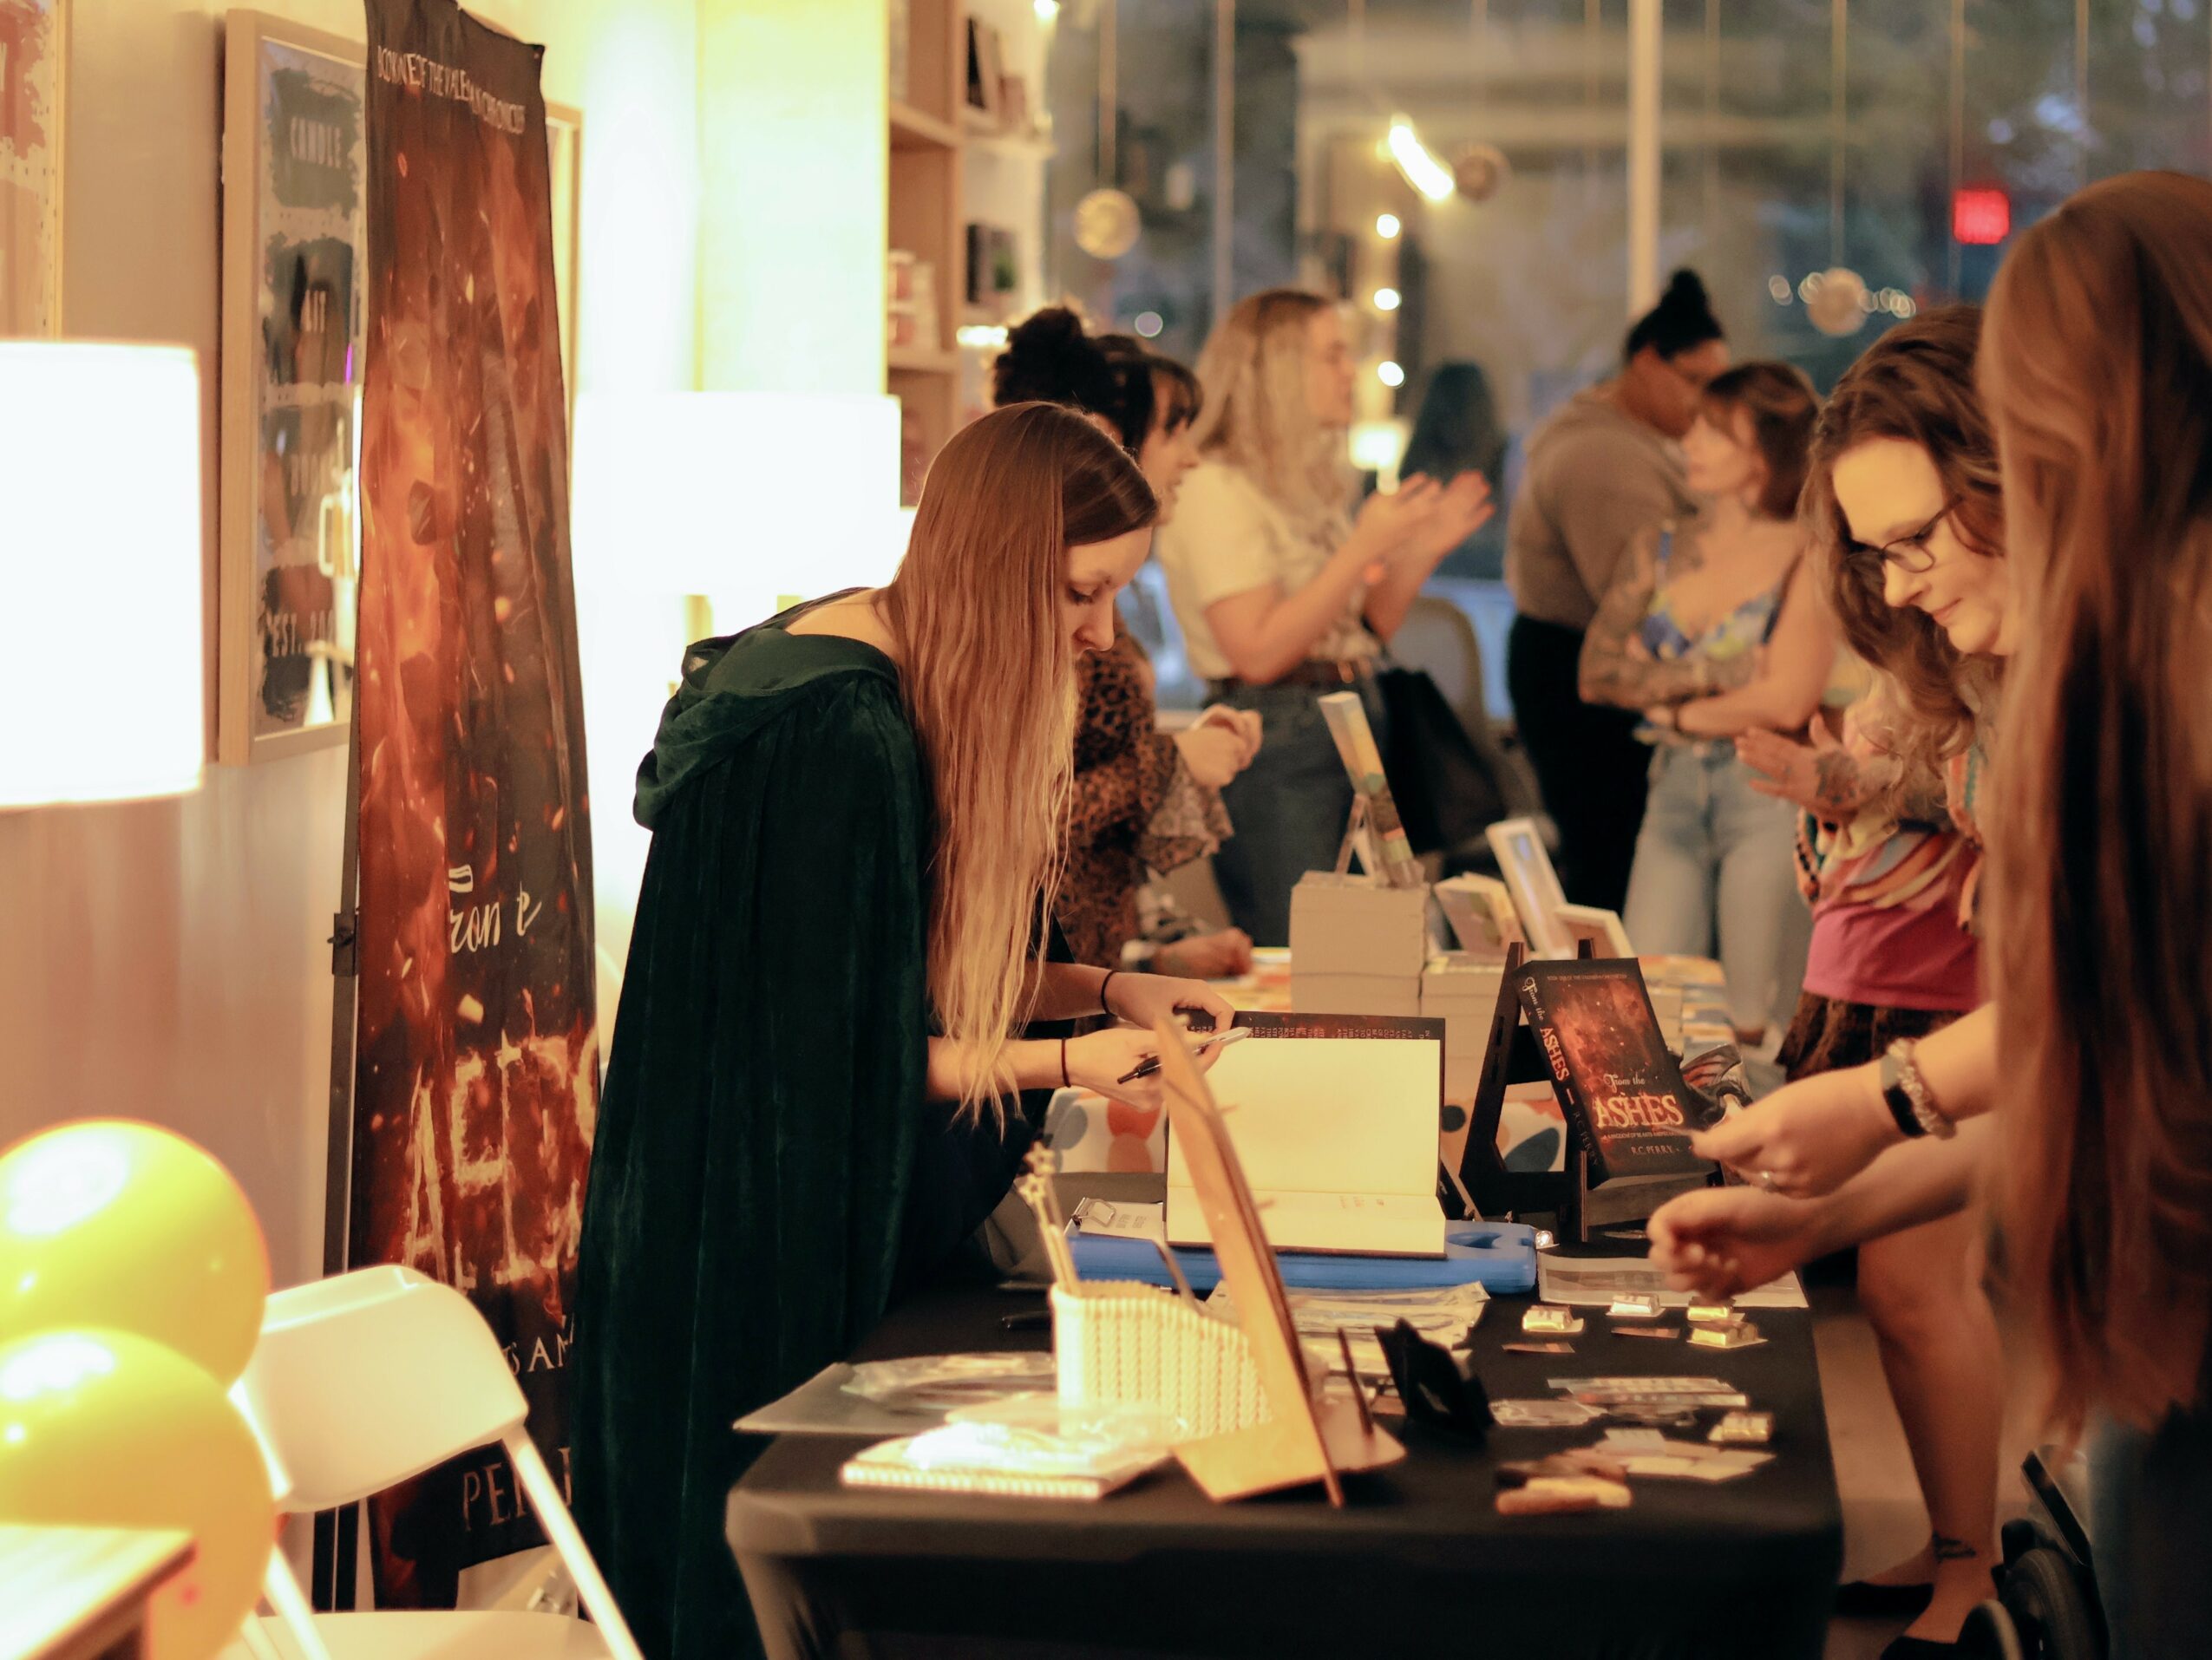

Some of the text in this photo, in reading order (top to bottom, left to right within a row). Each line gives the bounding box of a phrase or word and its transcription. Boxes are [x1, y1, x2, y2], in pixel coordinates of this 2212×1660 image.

[290, 116, 342, 169] CANDLE
[1522, 977, 1538, 1005] From
[1535, 1007, 1546, 1021] the
[1540, 1027, 1570, 1082] ASHES
[1603, 1072, 1646, 1094] From the
[1594, 1093, 1684, 1129] ASHES
[1646, 1145, 1673, 1155] PERRY
